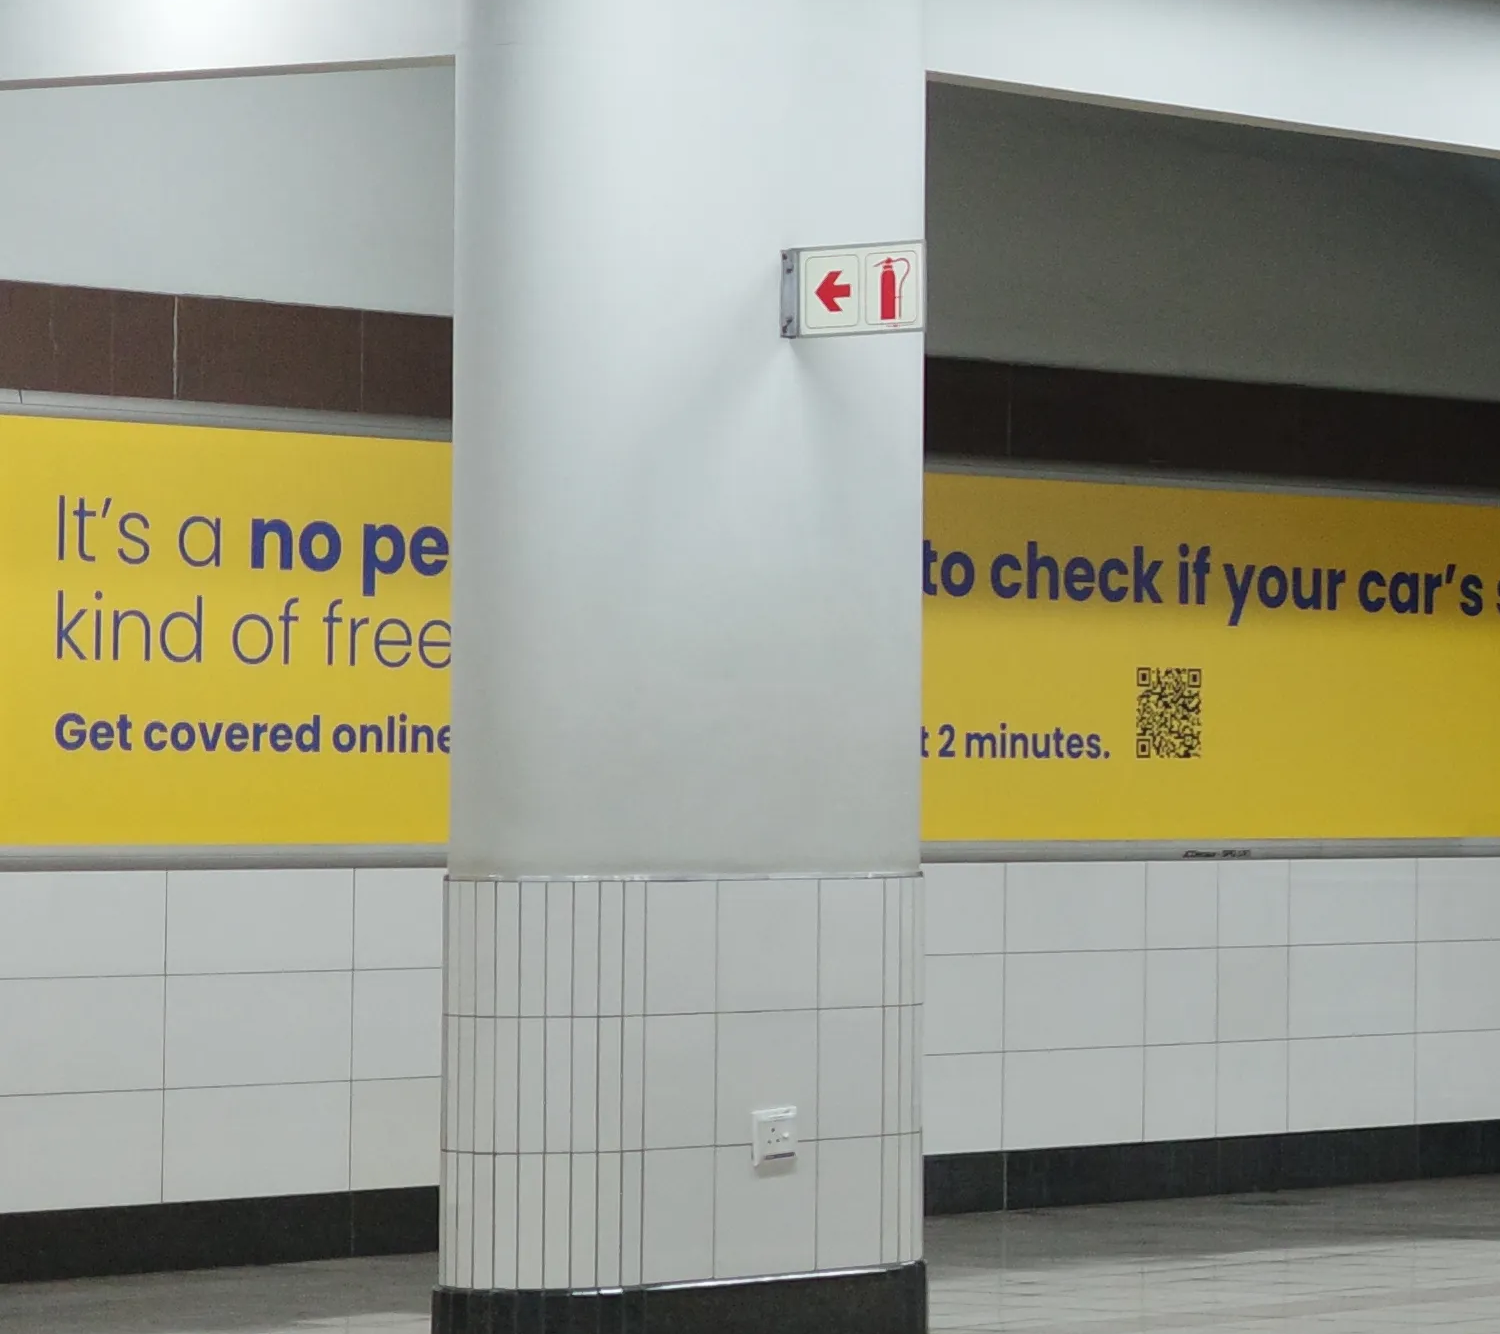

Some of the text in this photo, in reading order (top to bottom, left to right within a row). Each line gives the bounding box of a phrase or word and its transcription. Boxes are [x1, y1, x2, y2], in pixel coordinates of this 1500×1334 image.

[57, 495, 449, 597] It’s a no pe
[922, 539, 975, 597] to
[990, 540, 1164, 603] check
[1178, 543, 1211, 605] if
[1223, 562, 1346, 626] your
[1357, 563, 1484, 616] car’s
[55, 589, 452, 668] kind of free
[55, 712, 132, 751] Get
[143, 713, 321, 753] covered
[938, 723, 956, 757] 2
[965, 723, 1110, 759] minutes.
